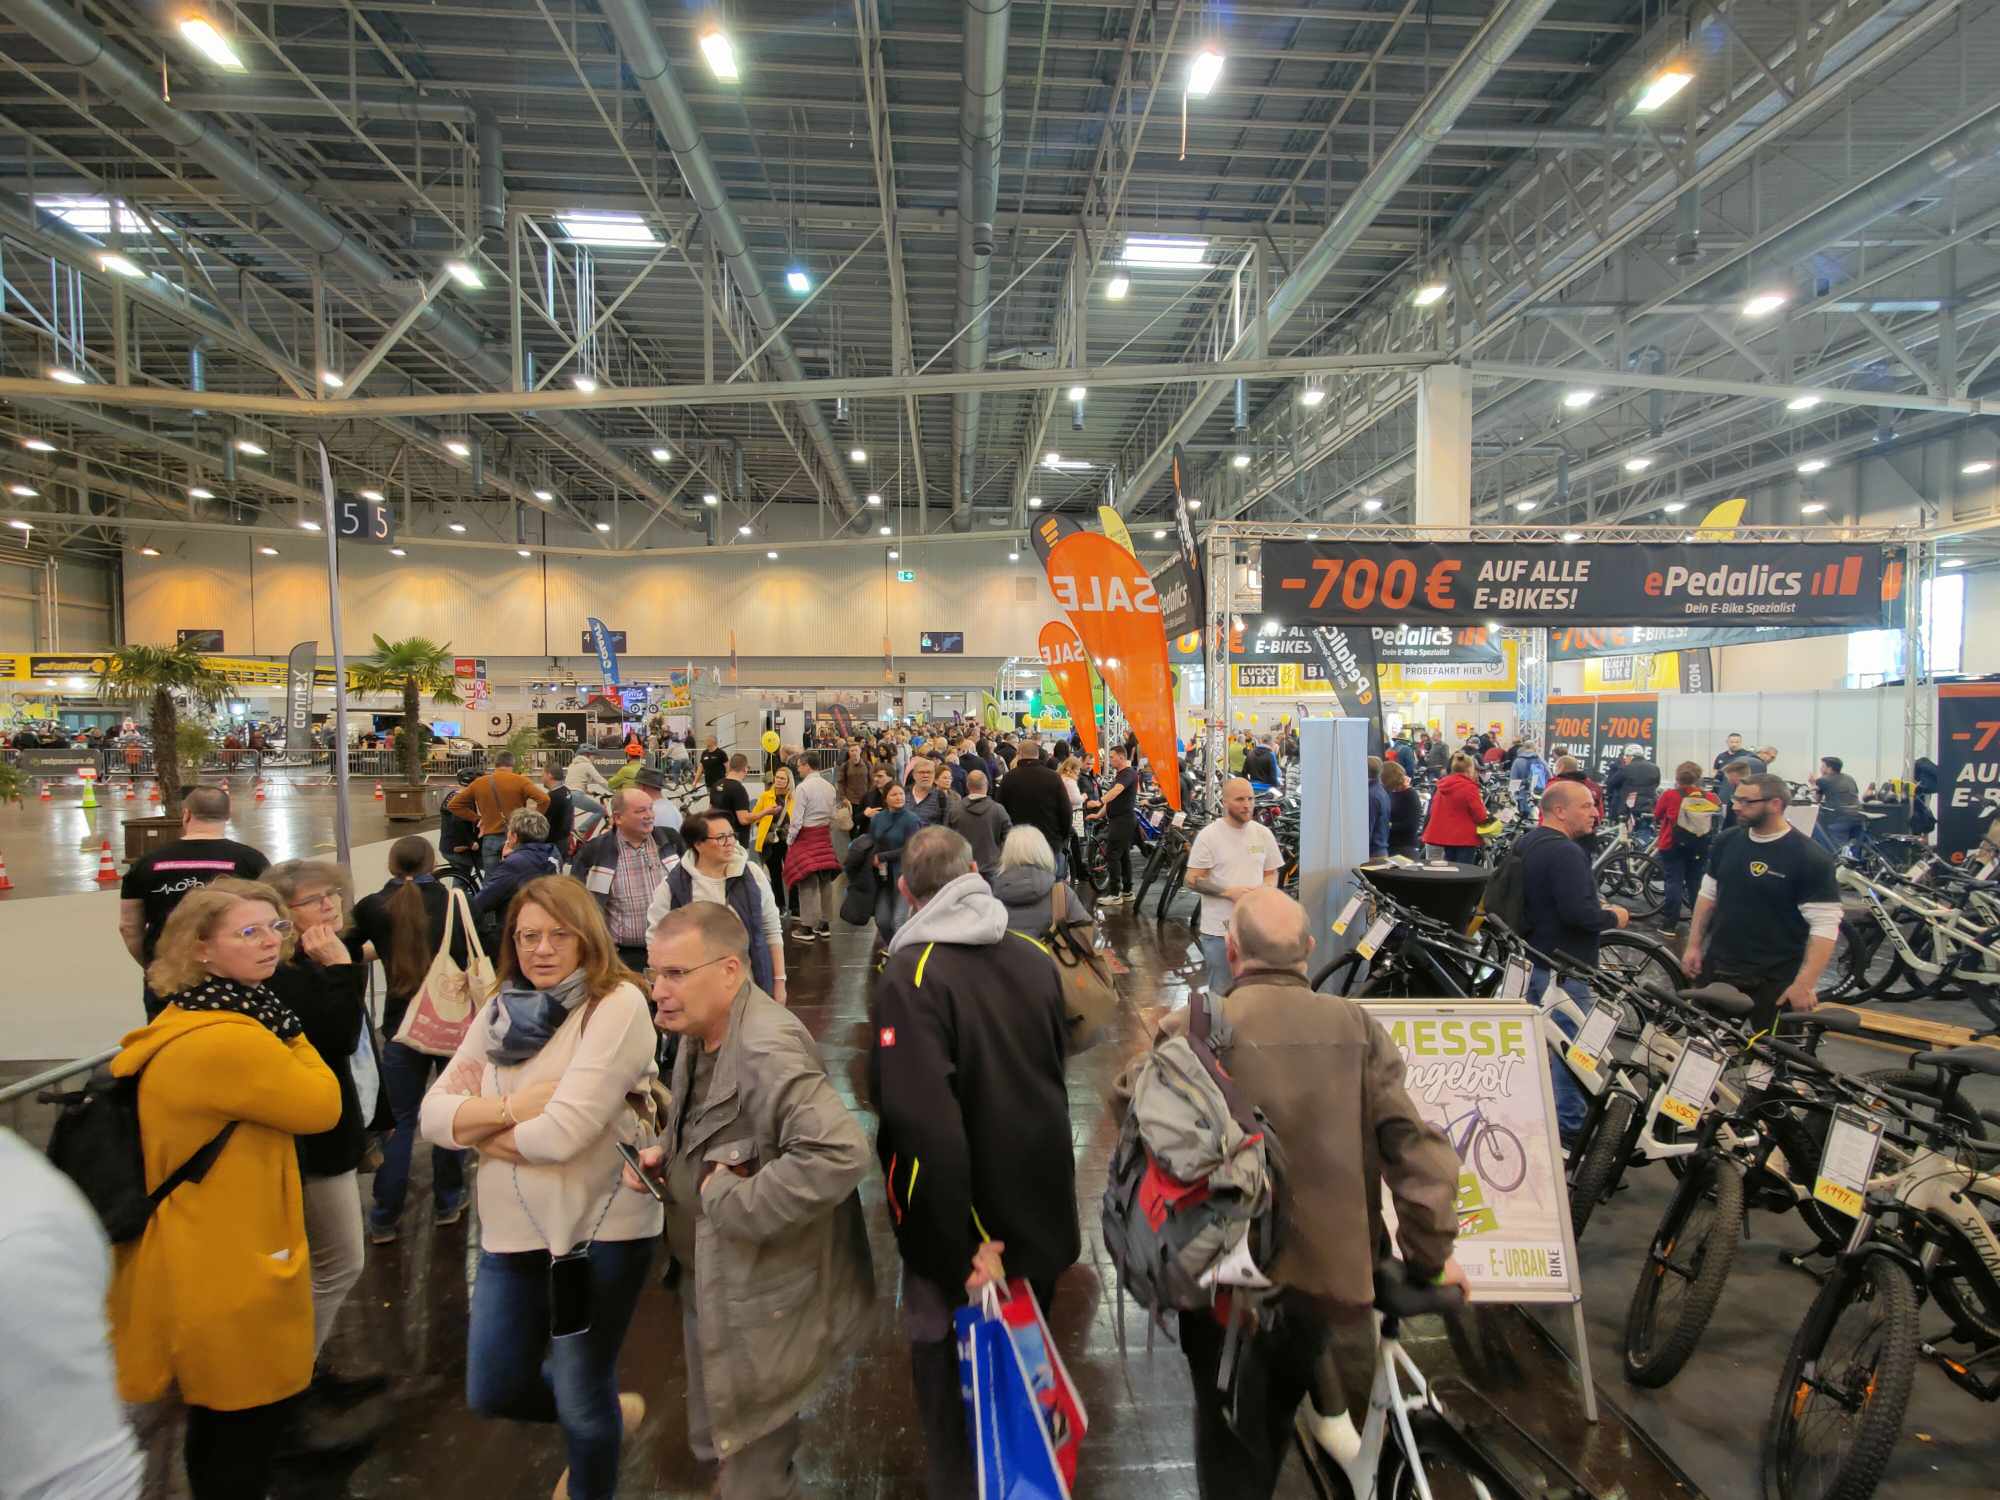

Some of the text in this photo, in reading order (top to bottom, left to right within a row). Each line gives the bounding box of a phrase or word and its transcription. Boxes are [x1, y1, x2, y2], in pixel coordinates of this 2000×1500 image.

[342, 503, 359, 534] 5
[376, 506, 388, 538] 5
[1477, 560, 1528, 582] AUF
[1529, 560, 1591, 583] ALLE
[1644, 565, 1802, 596] ePedalics
[1473, 588, 1578, 610] E-BIKES!
[1685, 602, 1796, 616] Dein E-Bike Spezialist
[583, 632, 591, 643] 4
[1372, 626, 1453, 646] Pedalics
[1240, 675, 1276, 685] BIKE
[1241, 667, 1277, 675] LUCKY
[1307, 667, 1324, 677] BI
[1405, 666, 1483, 675] PROBEFAHRT HIER
[1689, 664, 1701, 692] COM
[293, 669, 308, 729] connex
[1952, 721, 2000, 752] -7
[1956, 762, 2000, 783] AU
[1400, 1047, 1524, 1104] ngebot
[1488, 1248, 1549, 1277] E-URBAN
[1548, 1248, 1562, 1277] BIKE
